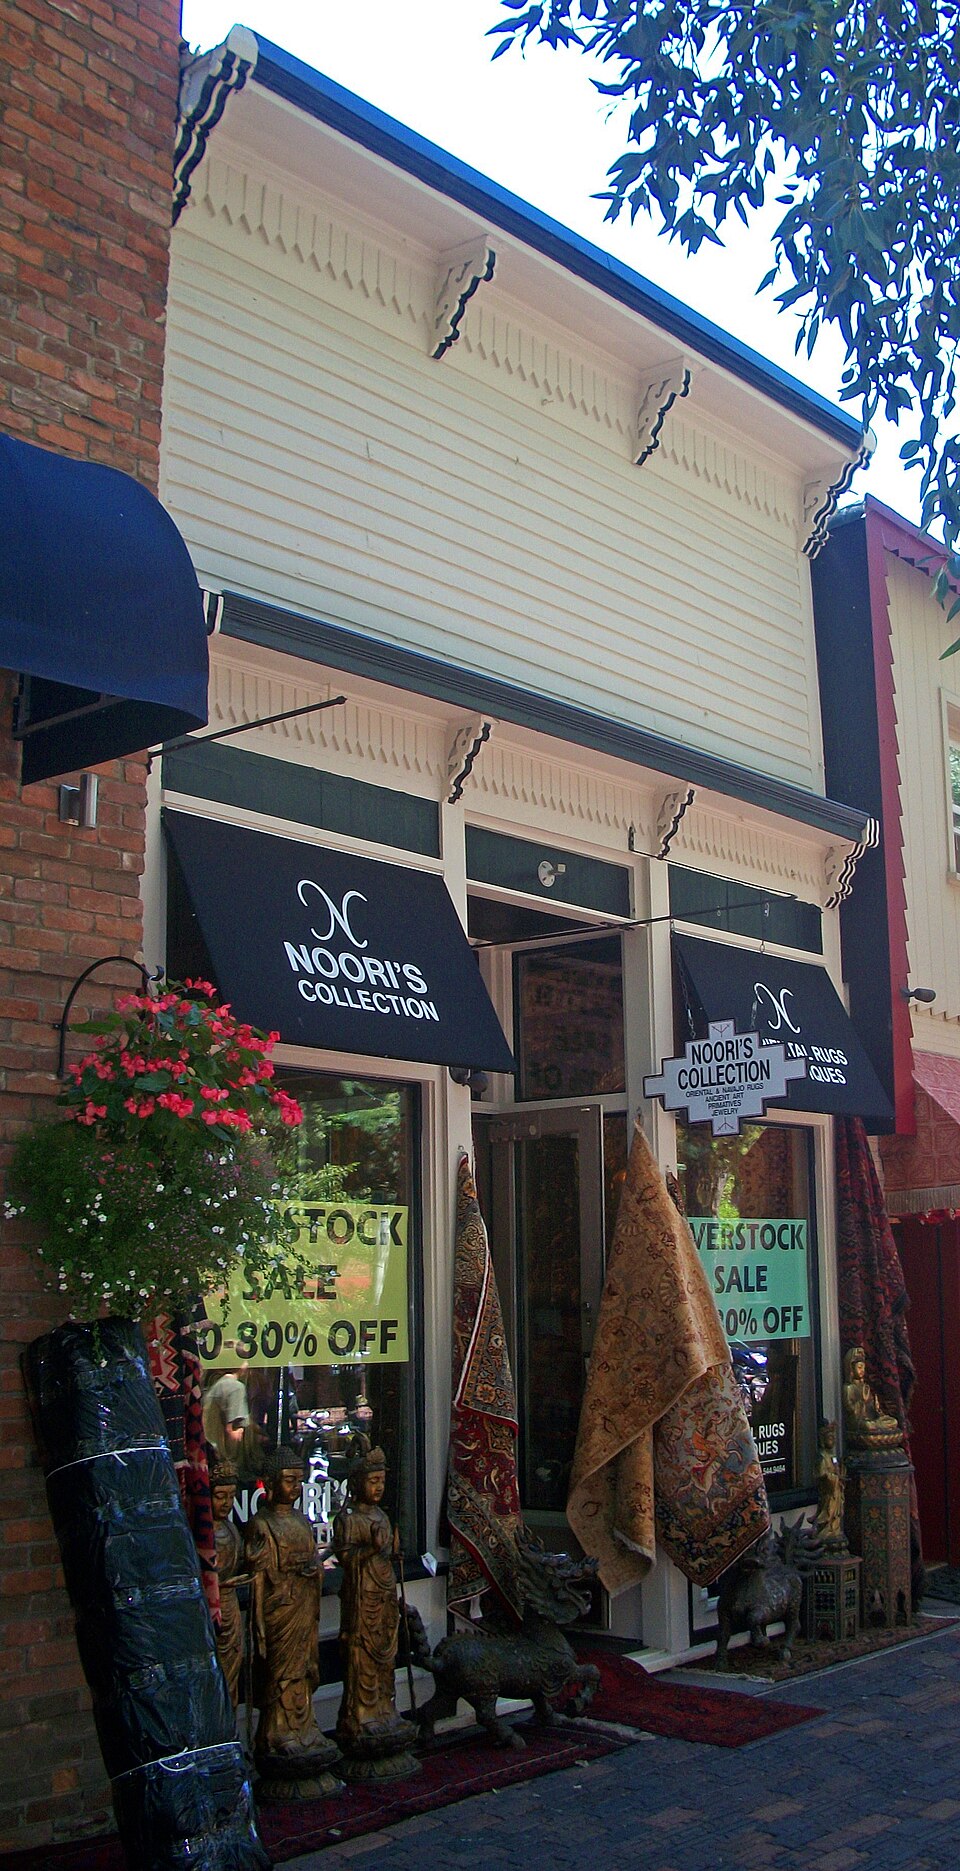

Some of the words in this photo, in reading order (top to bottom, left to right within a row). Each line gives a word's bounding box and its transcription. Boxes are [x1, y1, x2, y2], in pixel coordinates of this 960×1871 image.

[297, 879, 368, 948] N
[283, 941, 428, 994] NOORI'S
[298, 979, 440, 1022] COLLECTION
[753, 982, 801, 1034] N
[691, 1037, 753, 1065] NOORI'S
[811, 1046, 848, 1066] RUGS
[678, 1059, 770, 1090] COLLECTION
[685, 1089, 713, 1098] ORIENTAL
[722, 1085, 745, 1094] NAVAJO
[747, 1083, 764, 1091] RUGS
[705, 1094, 730, 1103] ANCIENT
[732, 1092, 745, 1100] ART
[711, 1108, 739, 1117] JEWELRY
[282, 1206, 403, 1246] STOCK
[689, 1222, 804, 1251] VERSTOCK
[243, 1264, 337, 1301] SALE
[714, 1265, 768, 1294] SALE
[763, 1305, 804, 1334] OFF
[200, 1321, 318, 1361] 0-80%
[327, 1319, 399, 1357] OFF
[758, 1422, 785, 1440] RUGS
